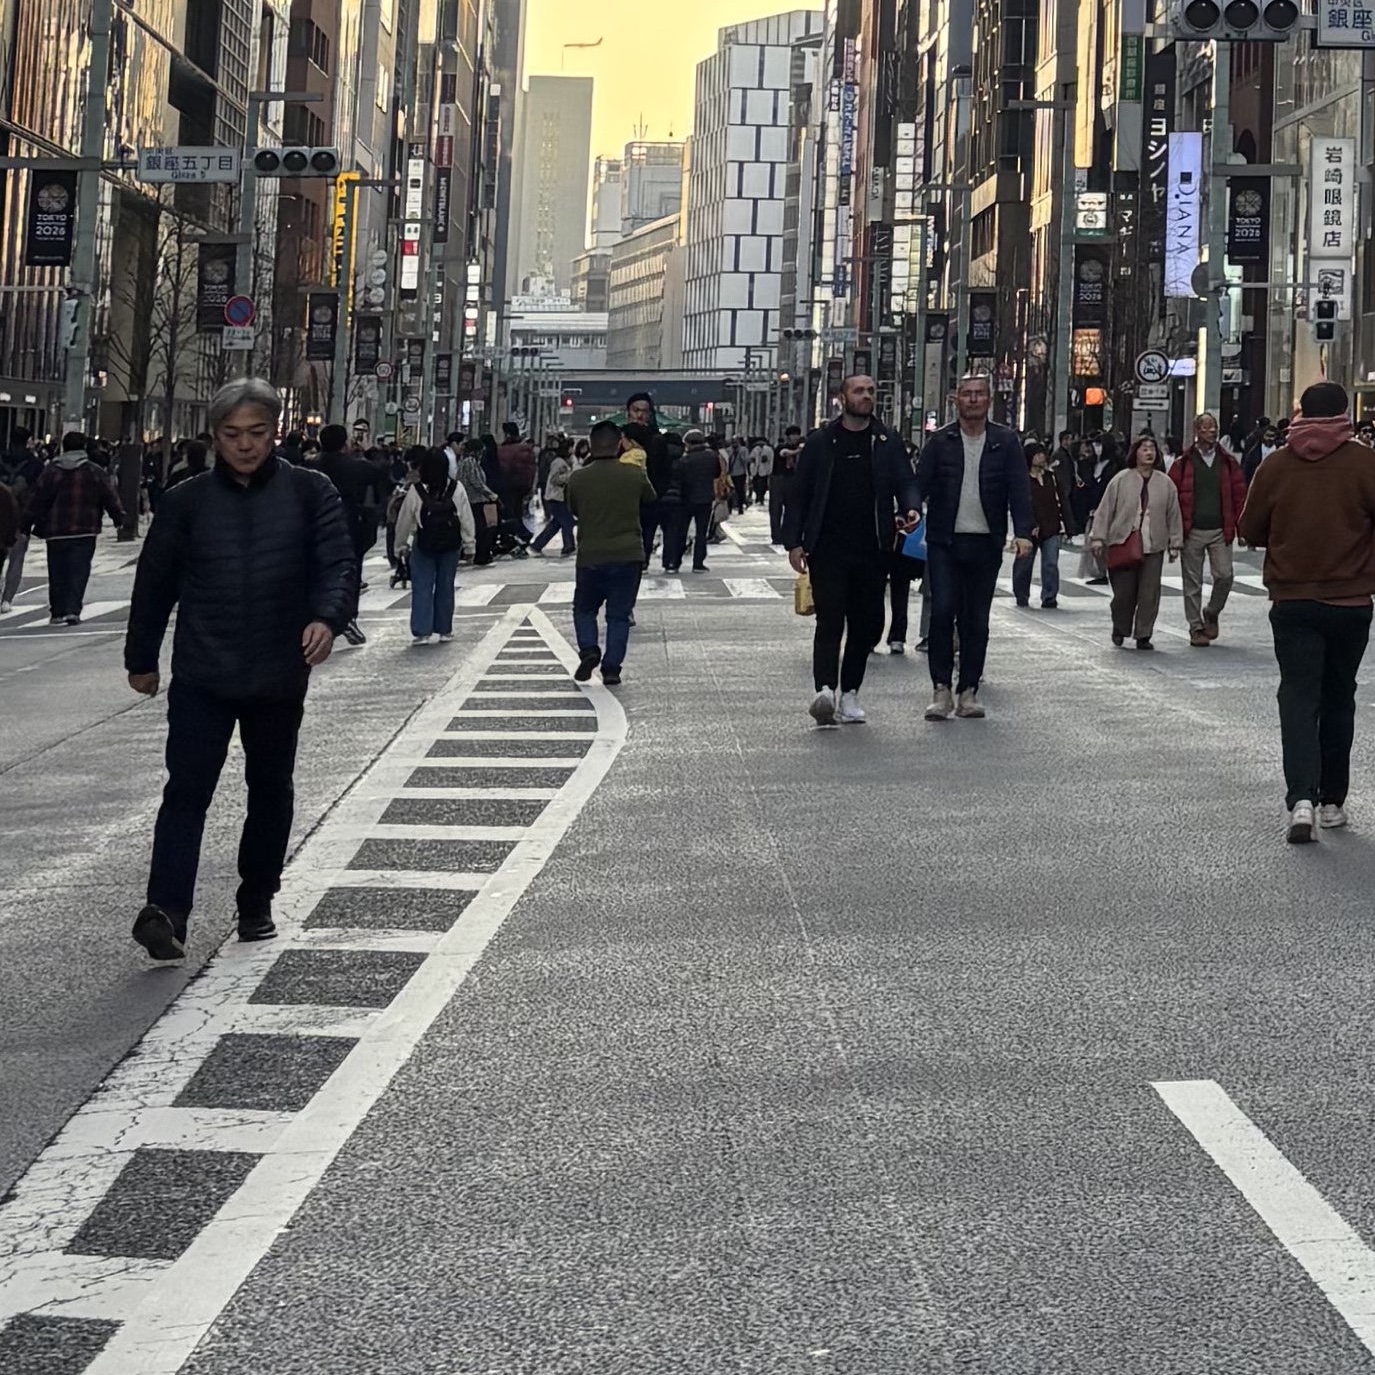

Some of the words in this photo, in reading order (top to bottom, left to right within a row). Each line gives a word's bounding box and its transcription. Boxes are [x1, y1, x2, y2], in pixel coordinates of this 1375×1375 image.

[146, 156, 233, 170] 銀座五丁目
[1323, 146, 1343, 248] 岩崎眼鏡店
